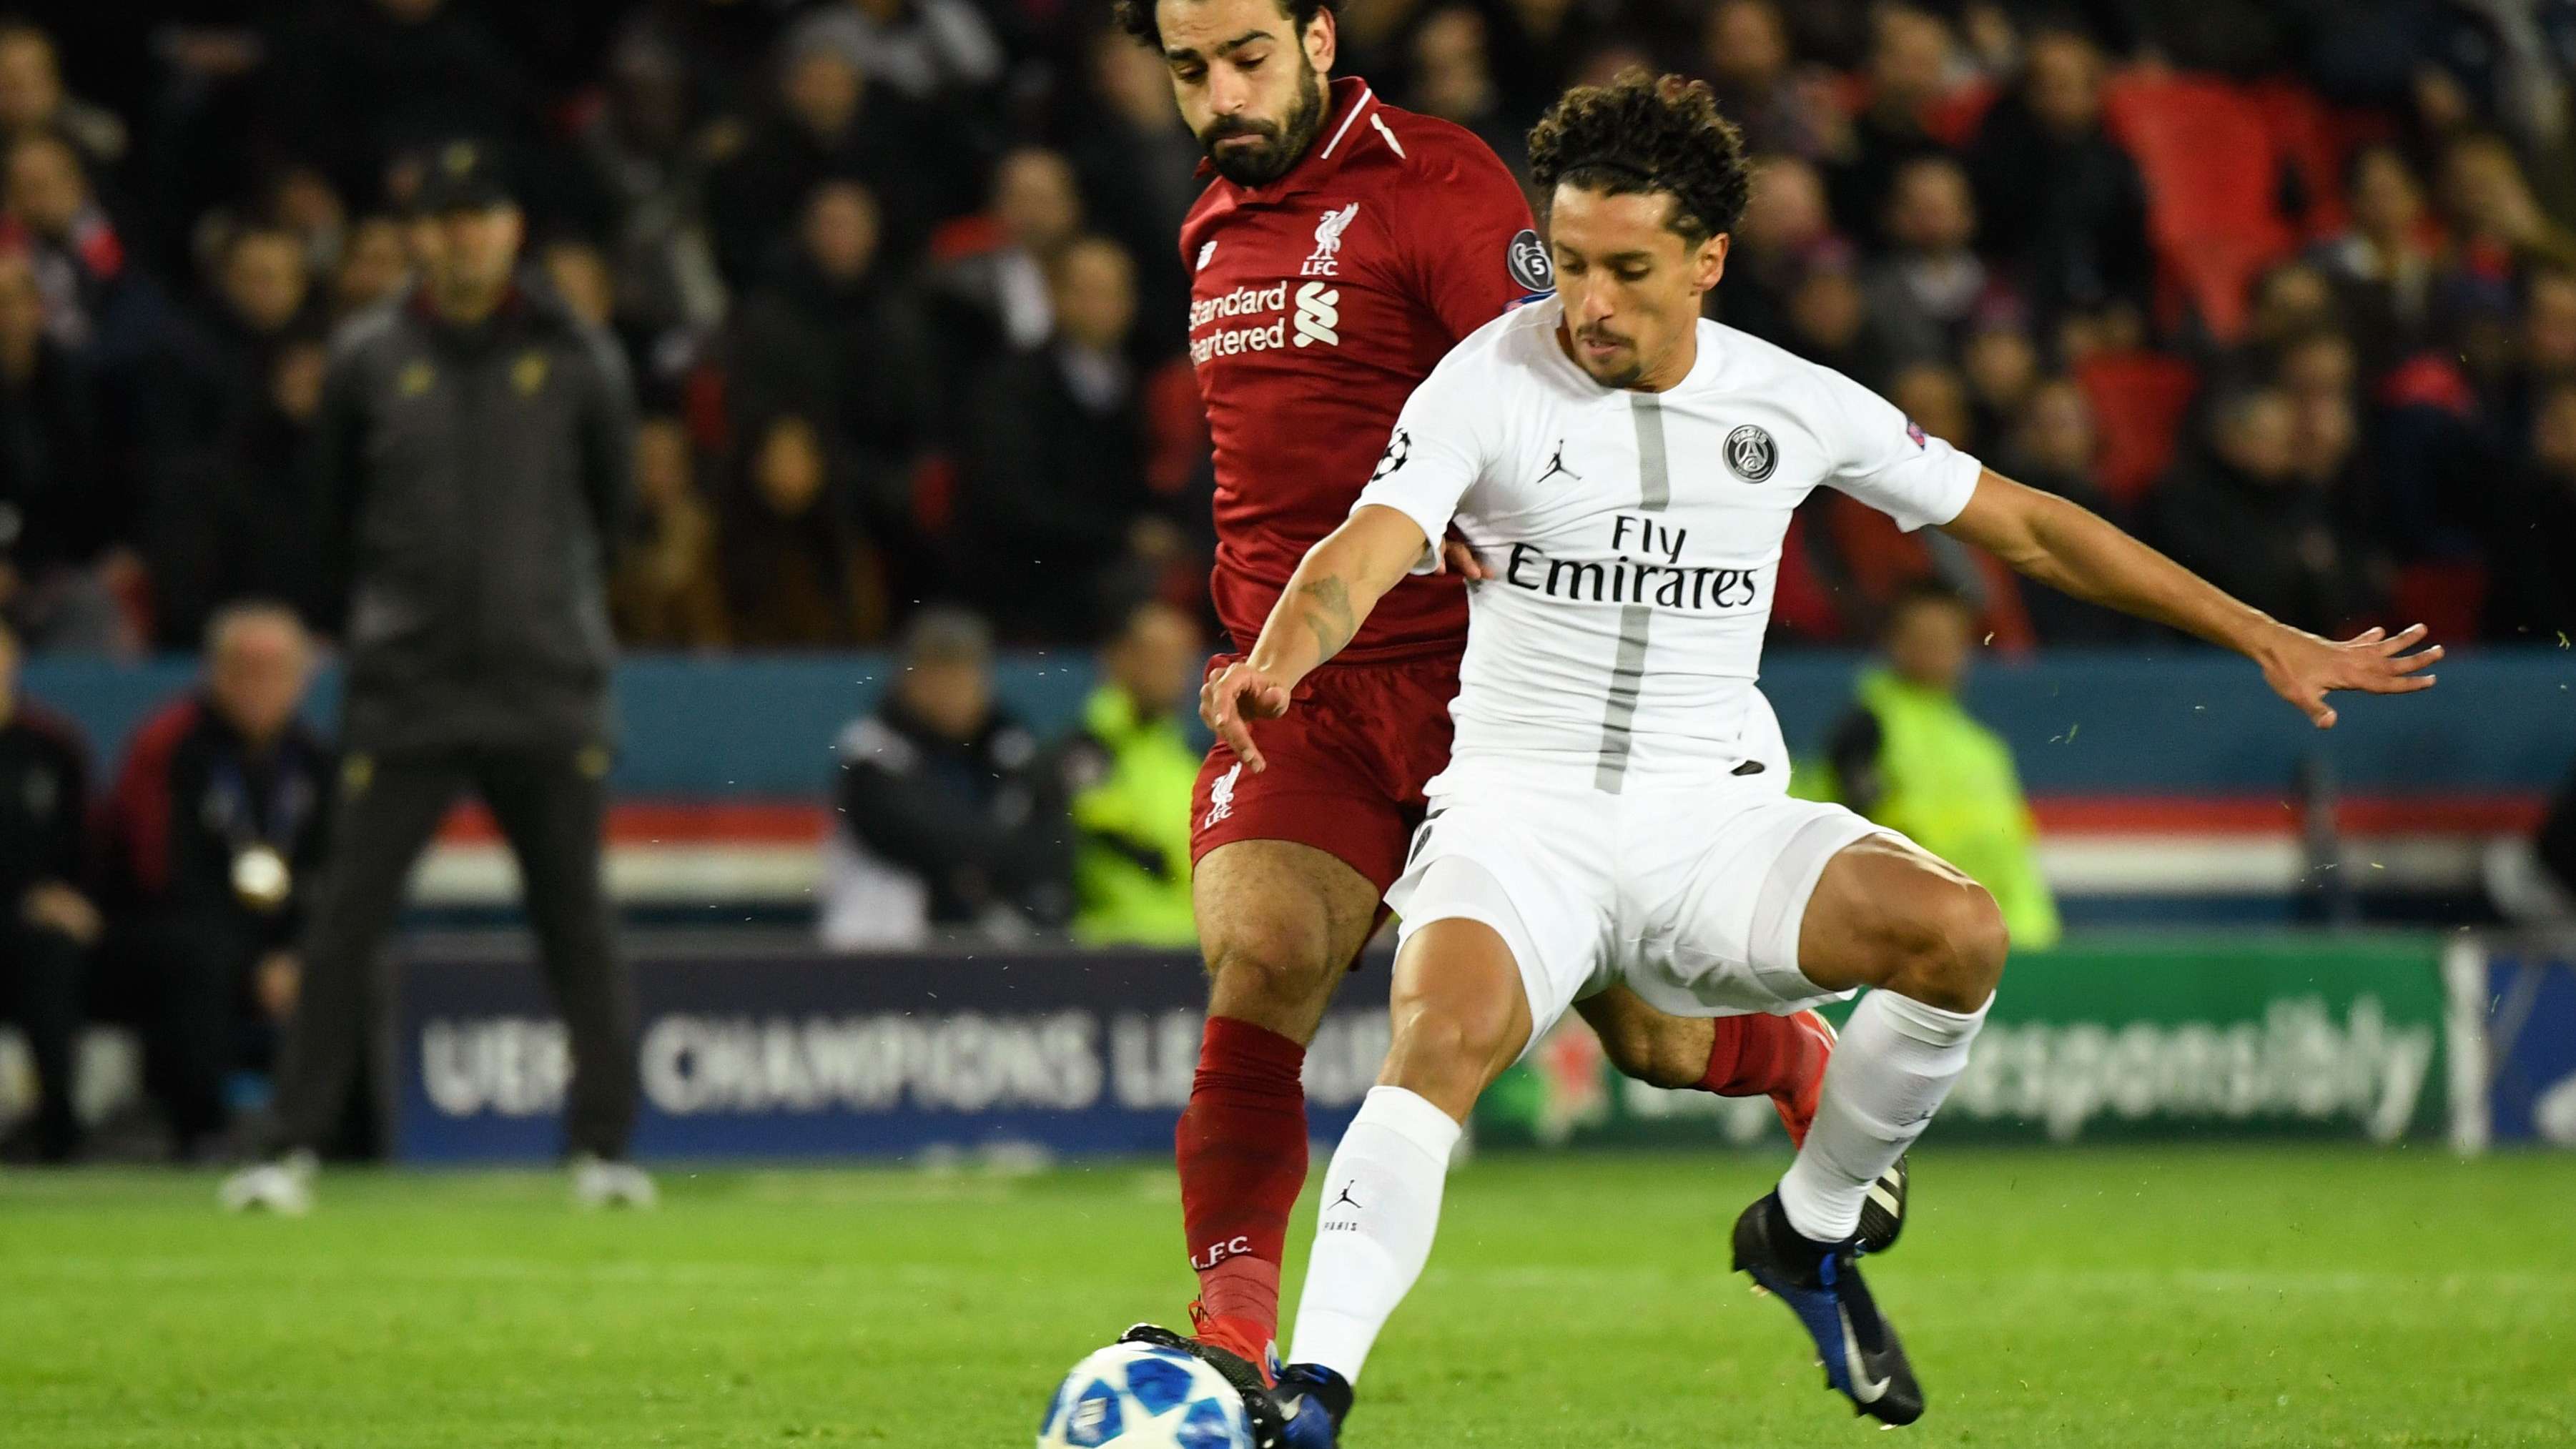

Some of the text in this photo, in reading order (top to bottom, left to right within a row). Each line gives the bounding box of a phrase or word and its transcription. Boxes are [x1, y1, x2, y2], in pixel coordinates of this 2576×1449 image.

[1300, 261, 1339, 275] LFC
[1531, 258, 1546, 275] 5
[1612, 515, 1687, 563] Fly
[1506, 541, 1757, 610] Emirates
[420, 1015, 573, 1117] UEF
[638, 1009, 1102, 1117] CHAMPIONS
